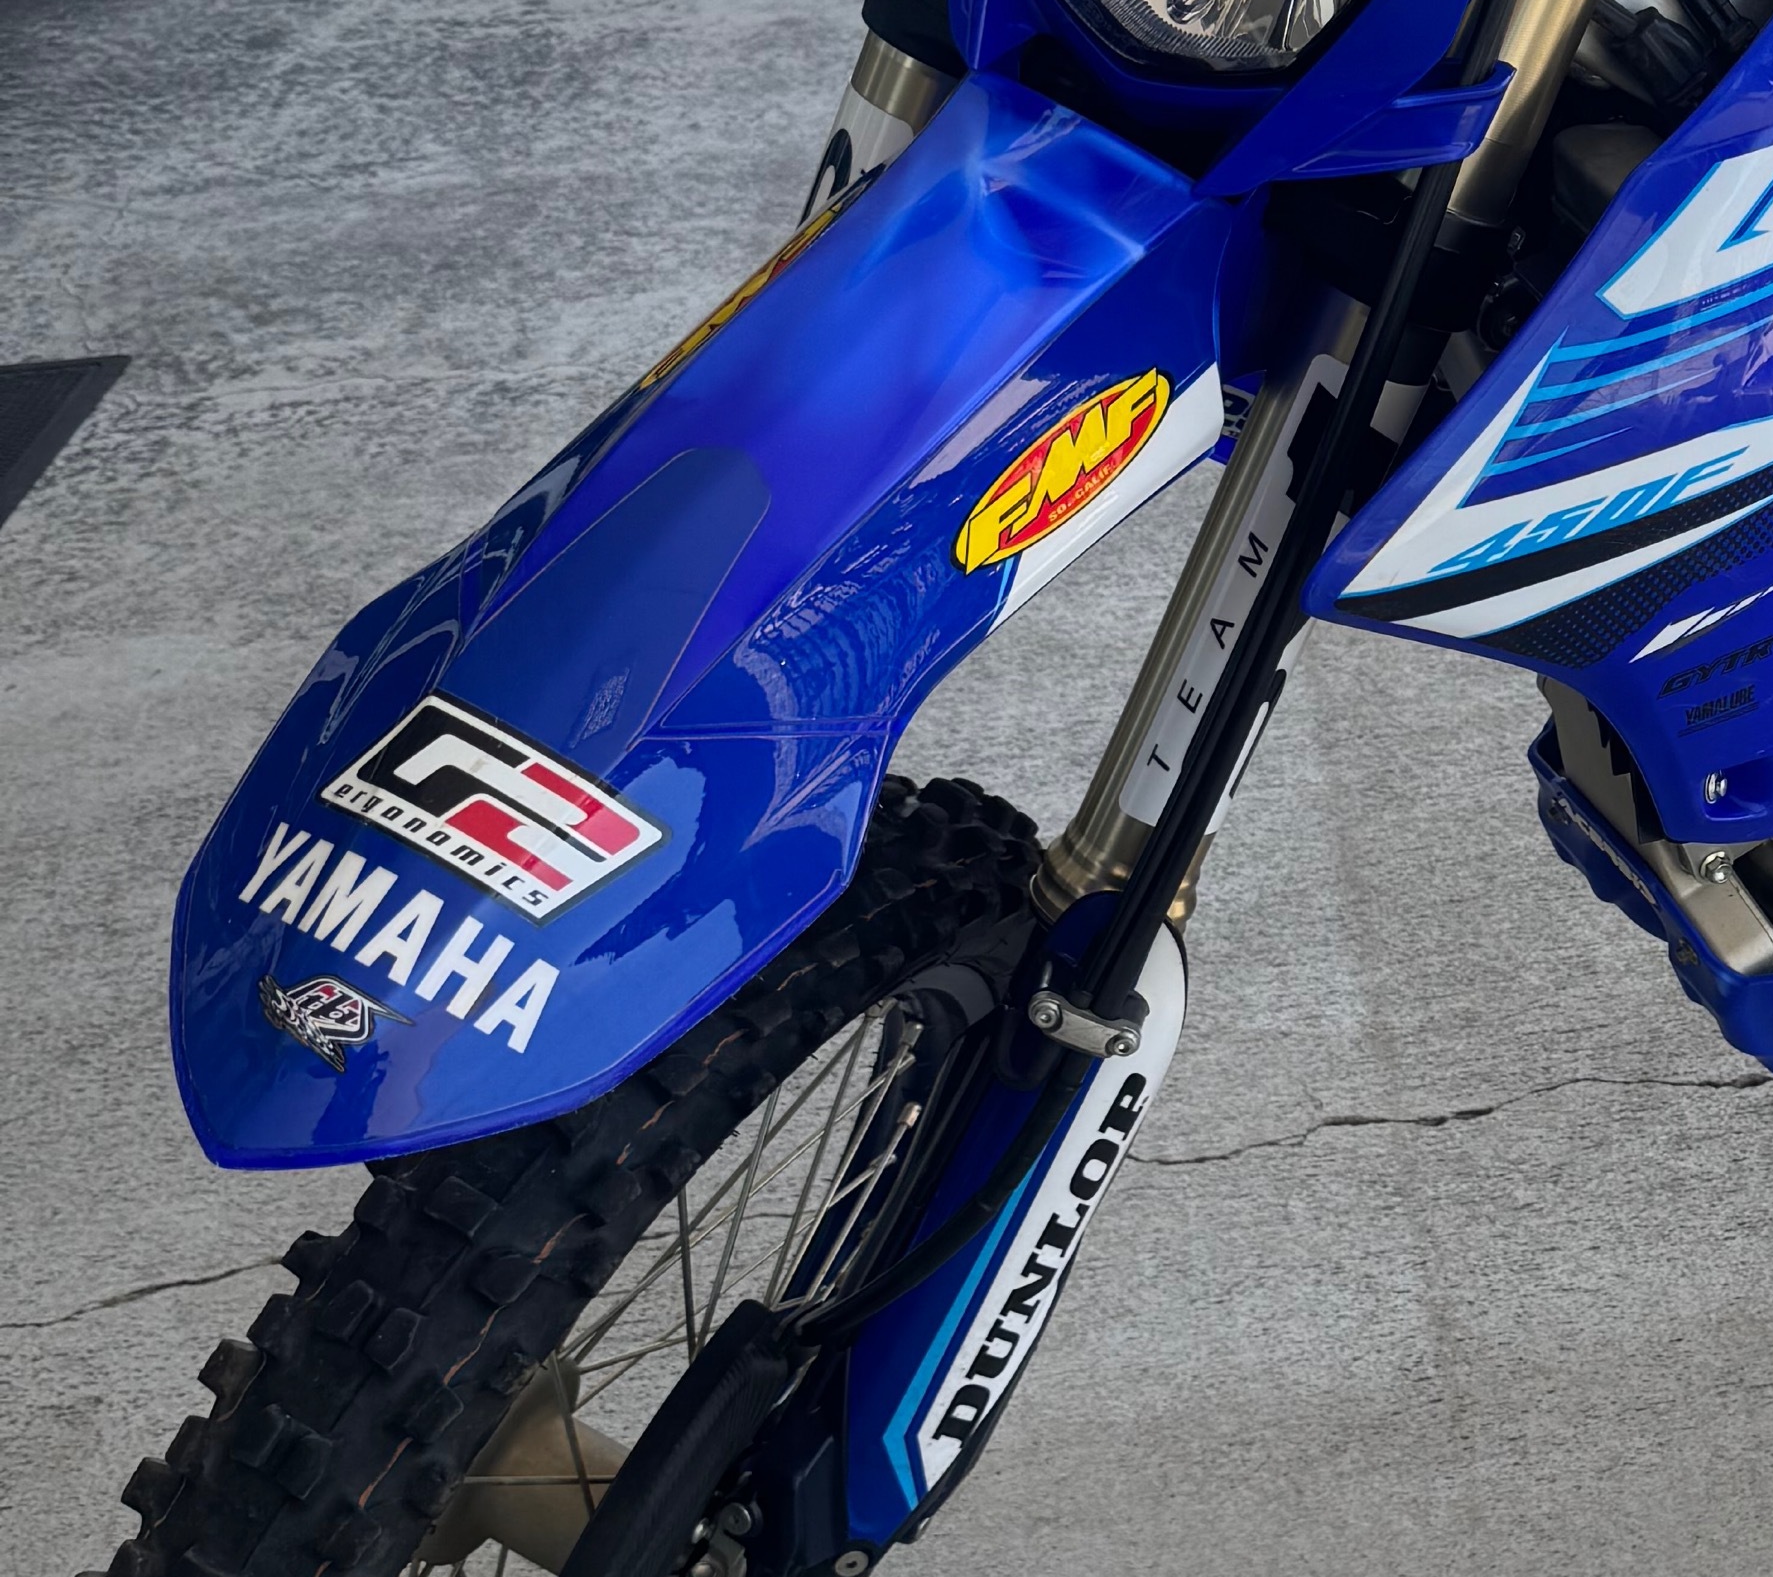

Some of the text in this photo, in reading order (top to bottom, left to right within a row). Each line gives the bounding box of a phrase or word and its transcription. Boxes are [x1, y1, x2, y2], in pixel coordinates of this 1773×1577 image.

[965, 366, 1158, 576] FMF
[1426, 444, 1751, 576] 450F
[1146, 532, 1270, 774] TEAM
[1685, 684, 1756, 726] YAMALUBE
[238, 821, 561, 1055] YAMAHA
[334, 782, 551, 908] ergonomics
[931, 1072, 1148, 1450] DUNLOP
